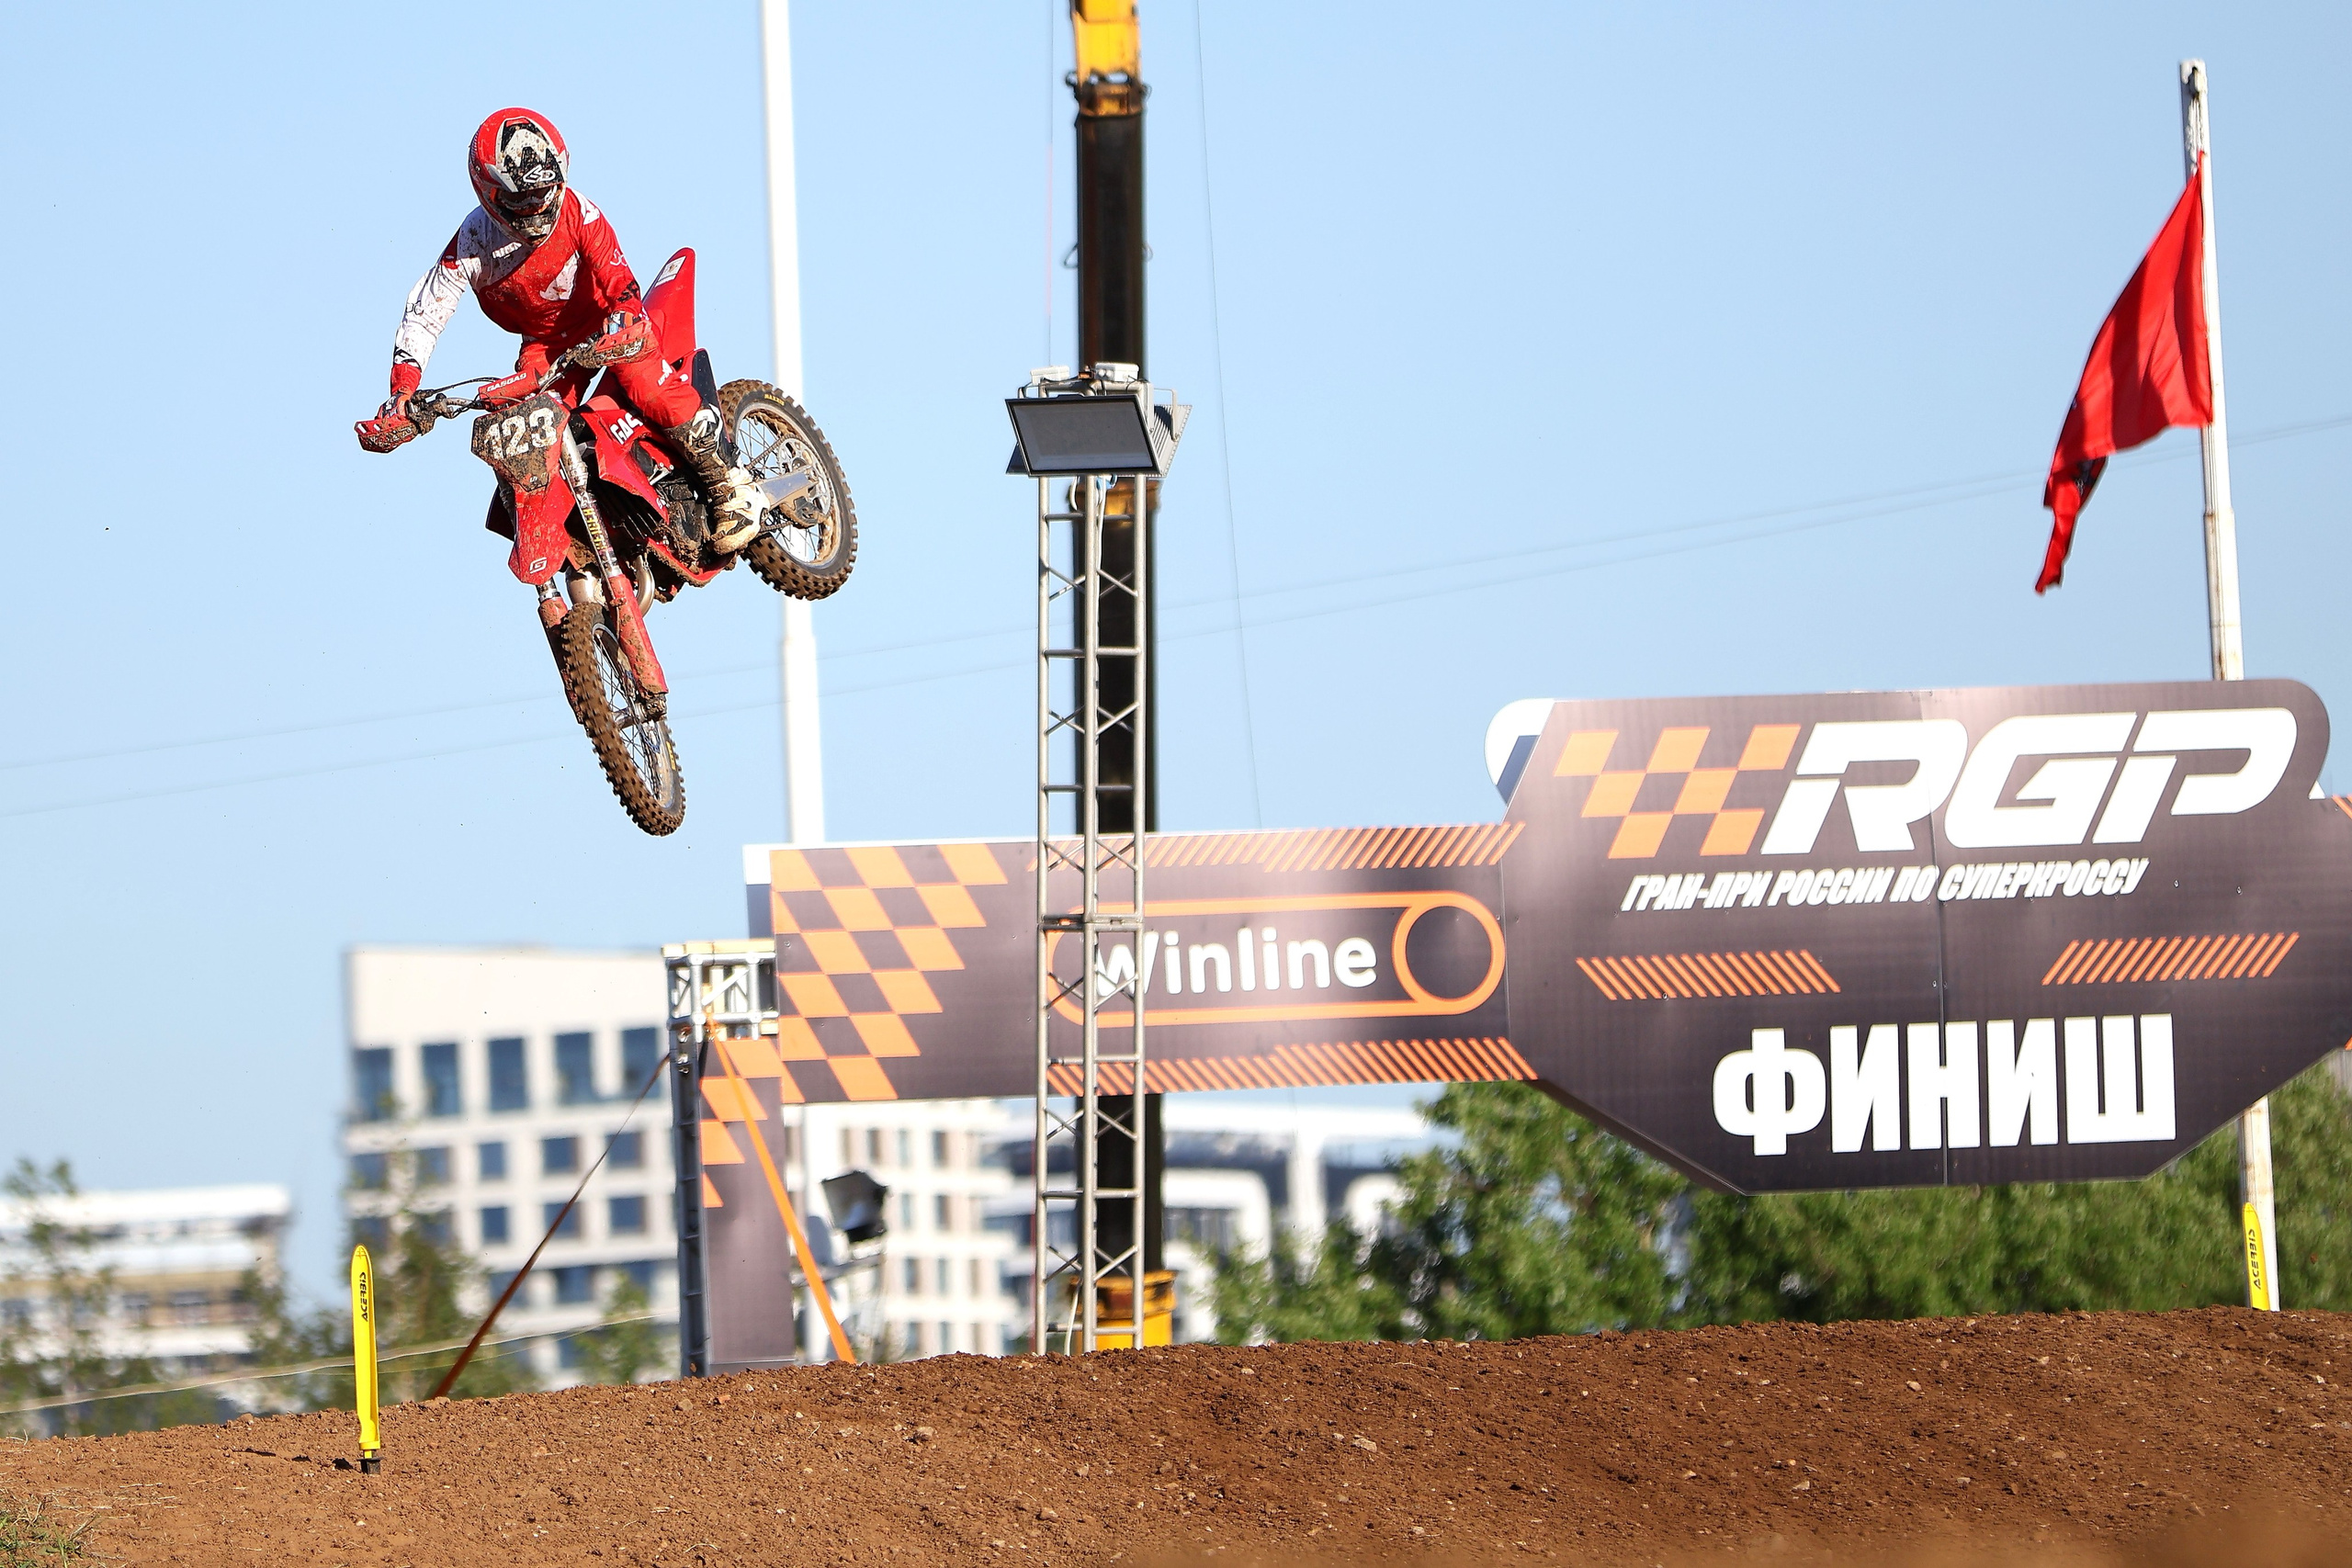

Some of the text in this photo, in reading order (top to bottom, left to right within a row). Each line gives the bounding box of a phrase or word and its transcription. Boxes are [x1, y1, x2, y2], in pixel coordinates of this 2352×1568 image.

[487, 372, 527, 392] GASGAS
[1760, 707, 2298, 854] RGP
[1620, 858, 2150, 912] ГРАН-ПРИ РОССИИ ПО СУПЕРКРОССУ
[1097, 927, 1377, 997] Winline
[1713, 1013, 2177, 1156] ФИНИШ
[358, 1271, 368, 1323] ACERBIS
